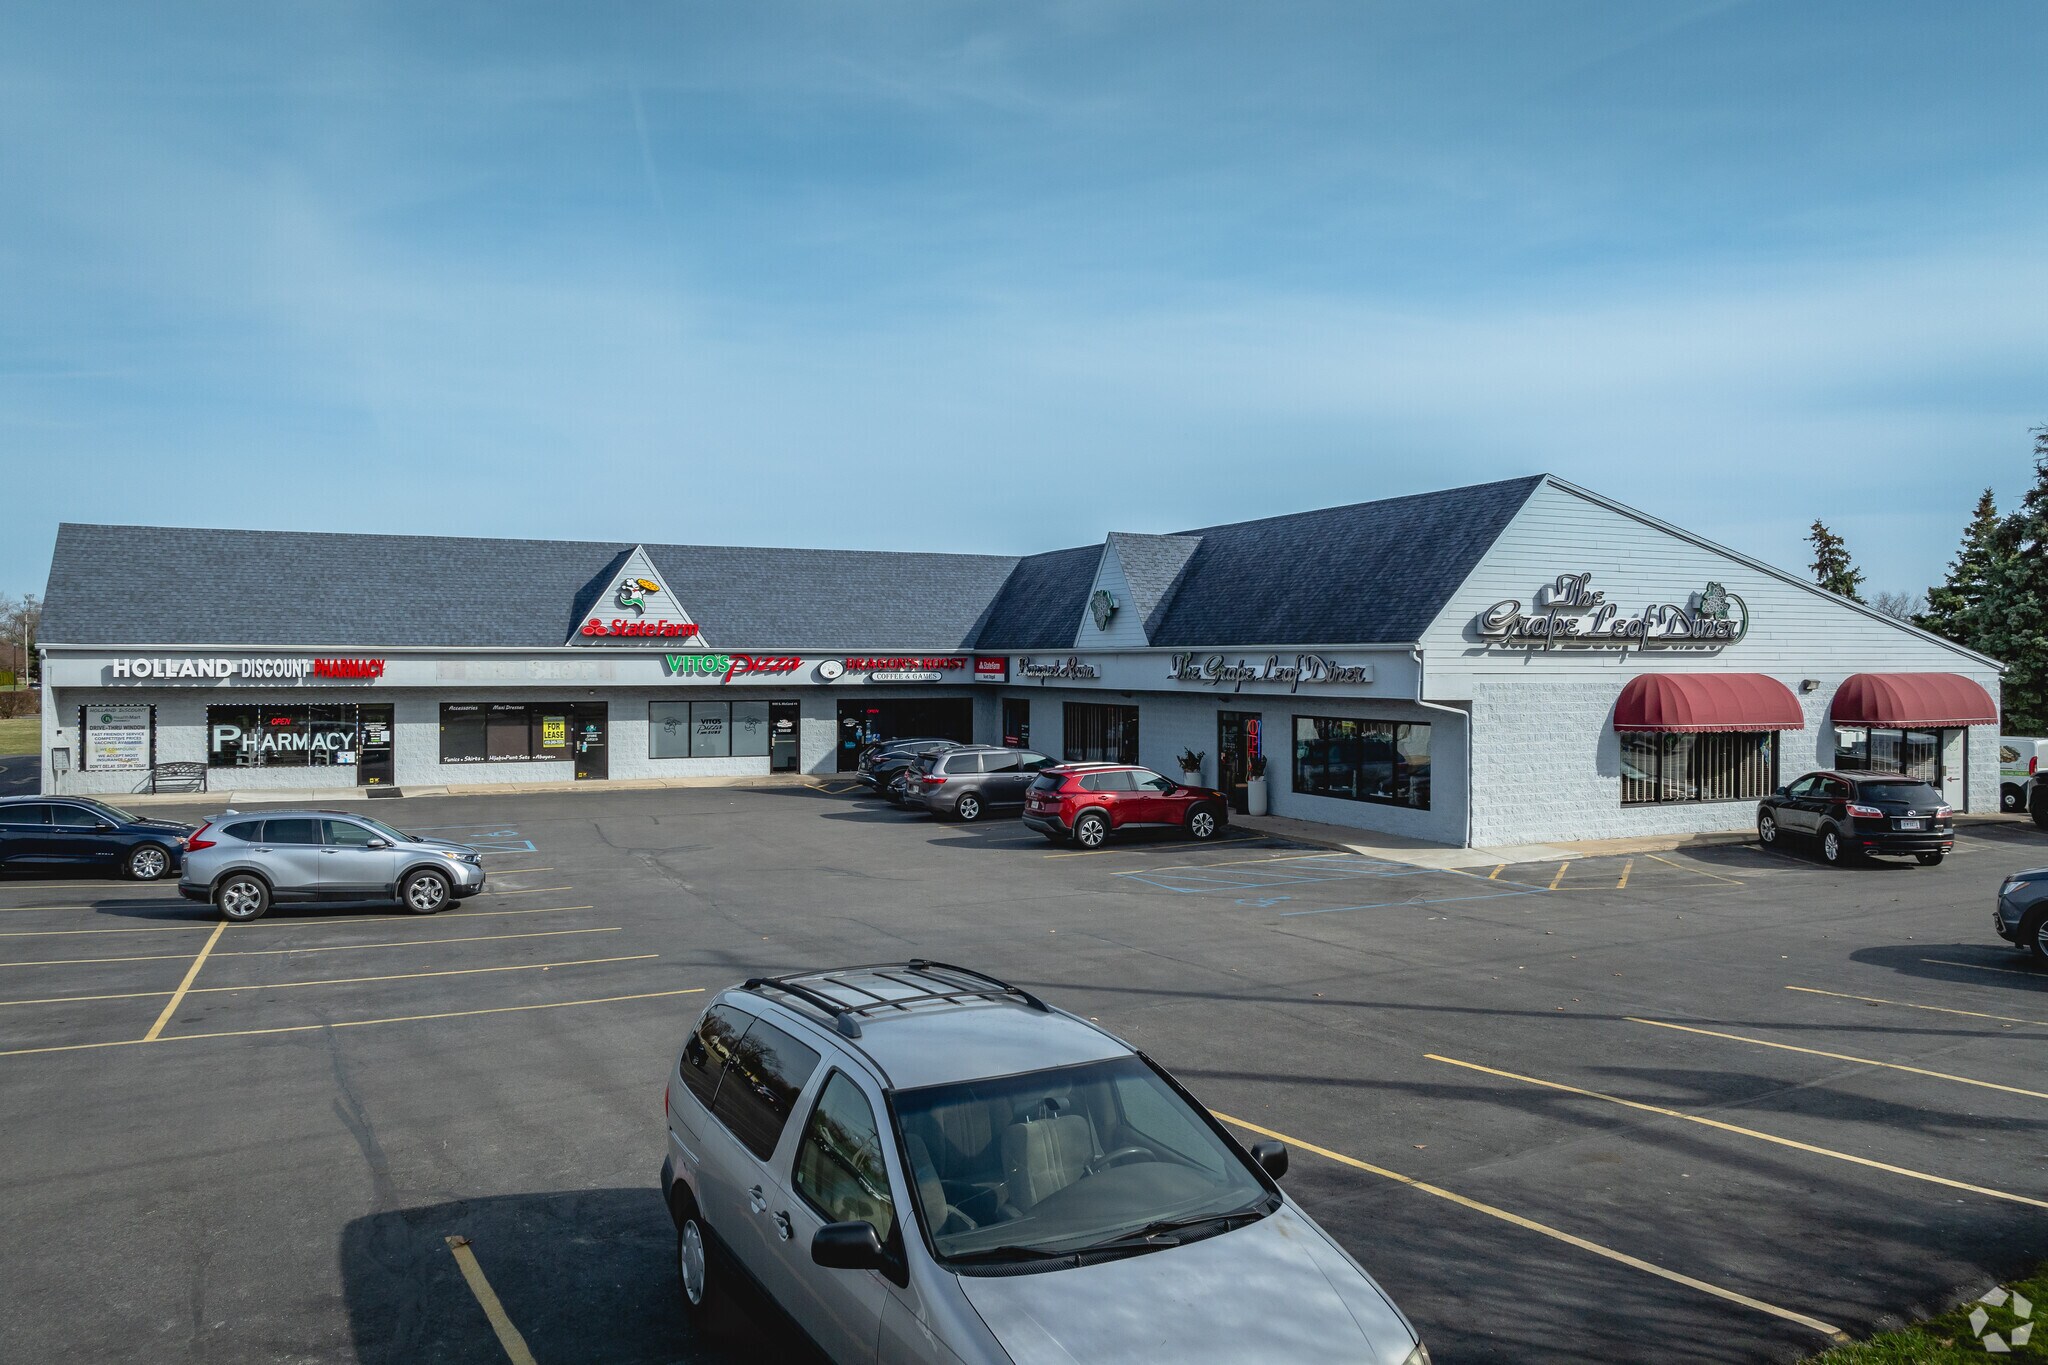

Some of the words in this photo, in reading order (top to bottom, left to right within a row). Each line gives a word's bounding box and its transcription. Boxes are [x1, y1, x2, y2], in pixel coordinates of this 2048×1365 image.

[1547, 571, 1606, 607] The
[1481, 599, 1580, 651] Grape
[1583, 602, 1657, 651] Leaf
[1658, 603, 1739, 639] Diner
[113, 658, 233, 678] HOLLAND
[241, 658, 308, 678] DISCOUNT
[313, 658, 385, 678] PHARMACY
[666, 654, 730, 672] VITO'S
[845, 657, 920, 671] DRAGON'S
[923, 657, 968, 670] ROOST
[1017, 656, 1060, 686] Banquet
[1060, 656, 1096, 680] Room
[1167, 652, 1201, 680] The
[1203, 655, 1256, 692] Grape
[1255, 654, 1304, 693] Leaf
[1304, 654, 1367, 683] Diner
[271, 717, 292, 726] OPEN
[547, 722, 561, 730] FOR
[213, 725, 355, 752] PHARMACY
[544, 731, 564, 739] LEASE
